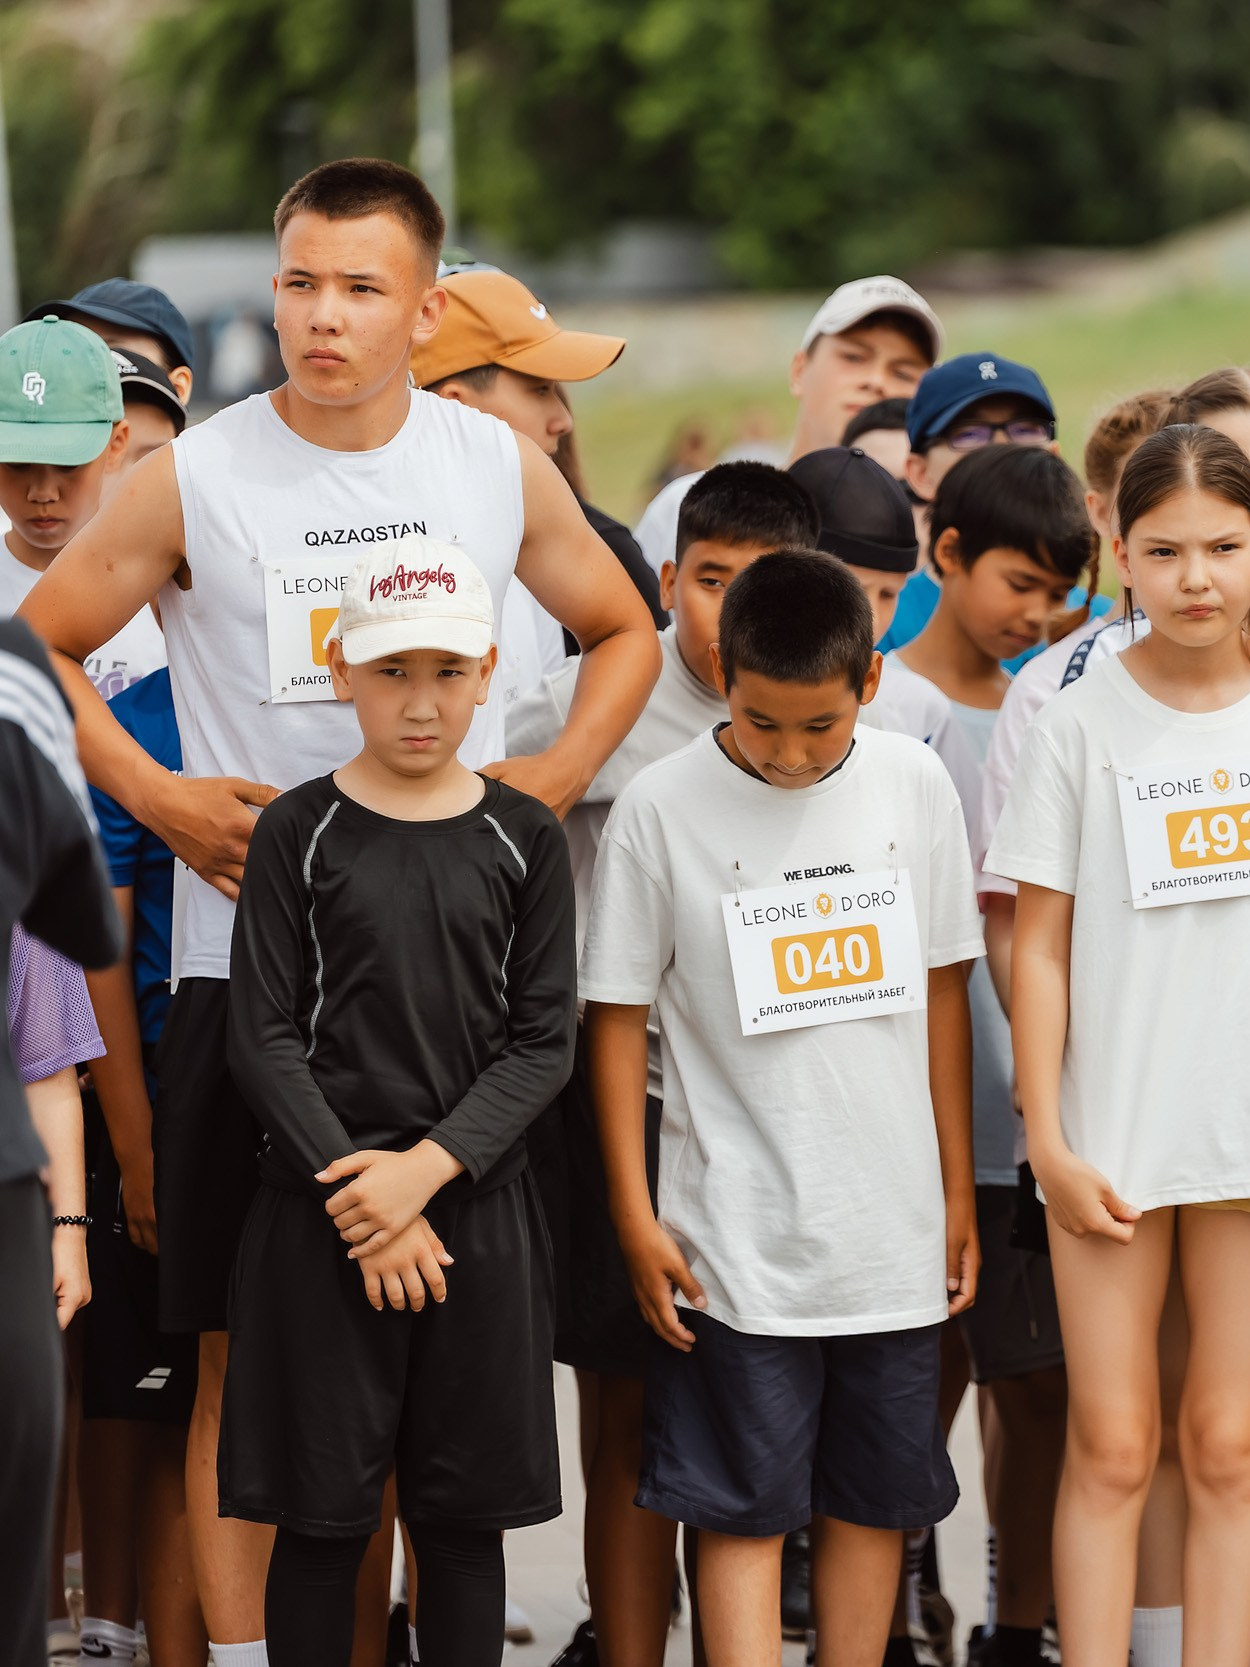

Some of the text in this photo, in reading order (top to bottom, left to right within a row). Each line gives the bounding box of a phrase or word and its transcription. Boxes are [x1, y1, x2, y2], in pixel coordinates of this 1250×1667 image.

[305, 521, 427, 546] QAZAQSTAN
[283, 576, 349, 594] LEONE
[393, 563, 456, 594] Angeles
[393, 592, 428, 602] VINTAGE
[1137, 778, 1204, 801] LEONE
[784, 863, 854, 882] WE BELONG.
[742, 890, 896, 926] LEONE D'ORO
[785, 933, 870, 985] 040
[759, 986, 907, 1017] БЛАГОТВОРИТЕЛЬНЫЙ ЗАБЕГ
